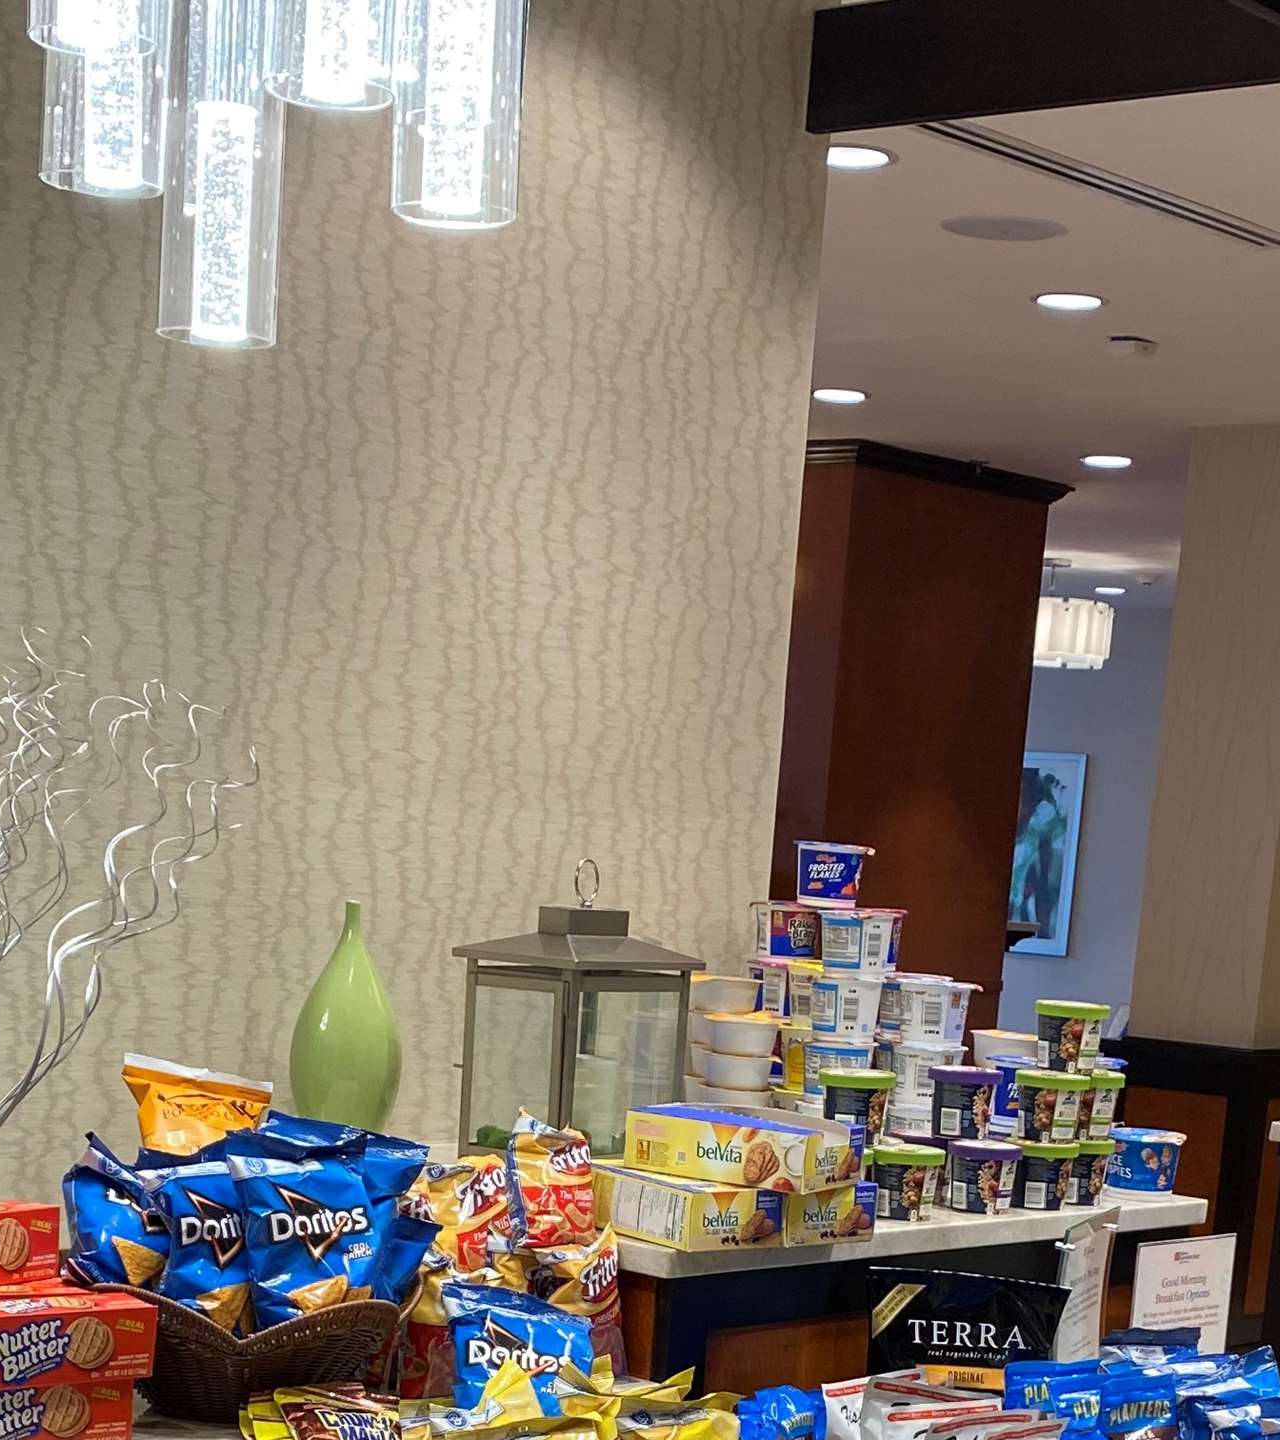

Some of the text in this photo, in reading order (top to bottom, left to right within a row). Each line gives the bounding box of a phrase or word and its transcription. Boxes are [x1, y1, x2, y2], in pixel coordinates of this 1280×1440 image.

[808, 862, 845, 872] FROSTED
[809, 870, 840, 879] FLAKES
[695, 1140, 743, 1165] belVita
[270, 1206, 369, 1242] Doritos
[702, 1208, 739, 1229] belVita
[803, 1207, 838, 1226] belVita
[179, 1212, 242, 1246] Dorit
[907, 1318, 1028, 1351] TERRA
[1, 1335, 69, 1382] Butter
[927, 1349, 943, 1357] real
[945, 1350, 982, 1360] vegetable
[948, 1370, 985, 1385] ORIGINAL
[1109, 1400, 1171, 1426] PLANTERS
